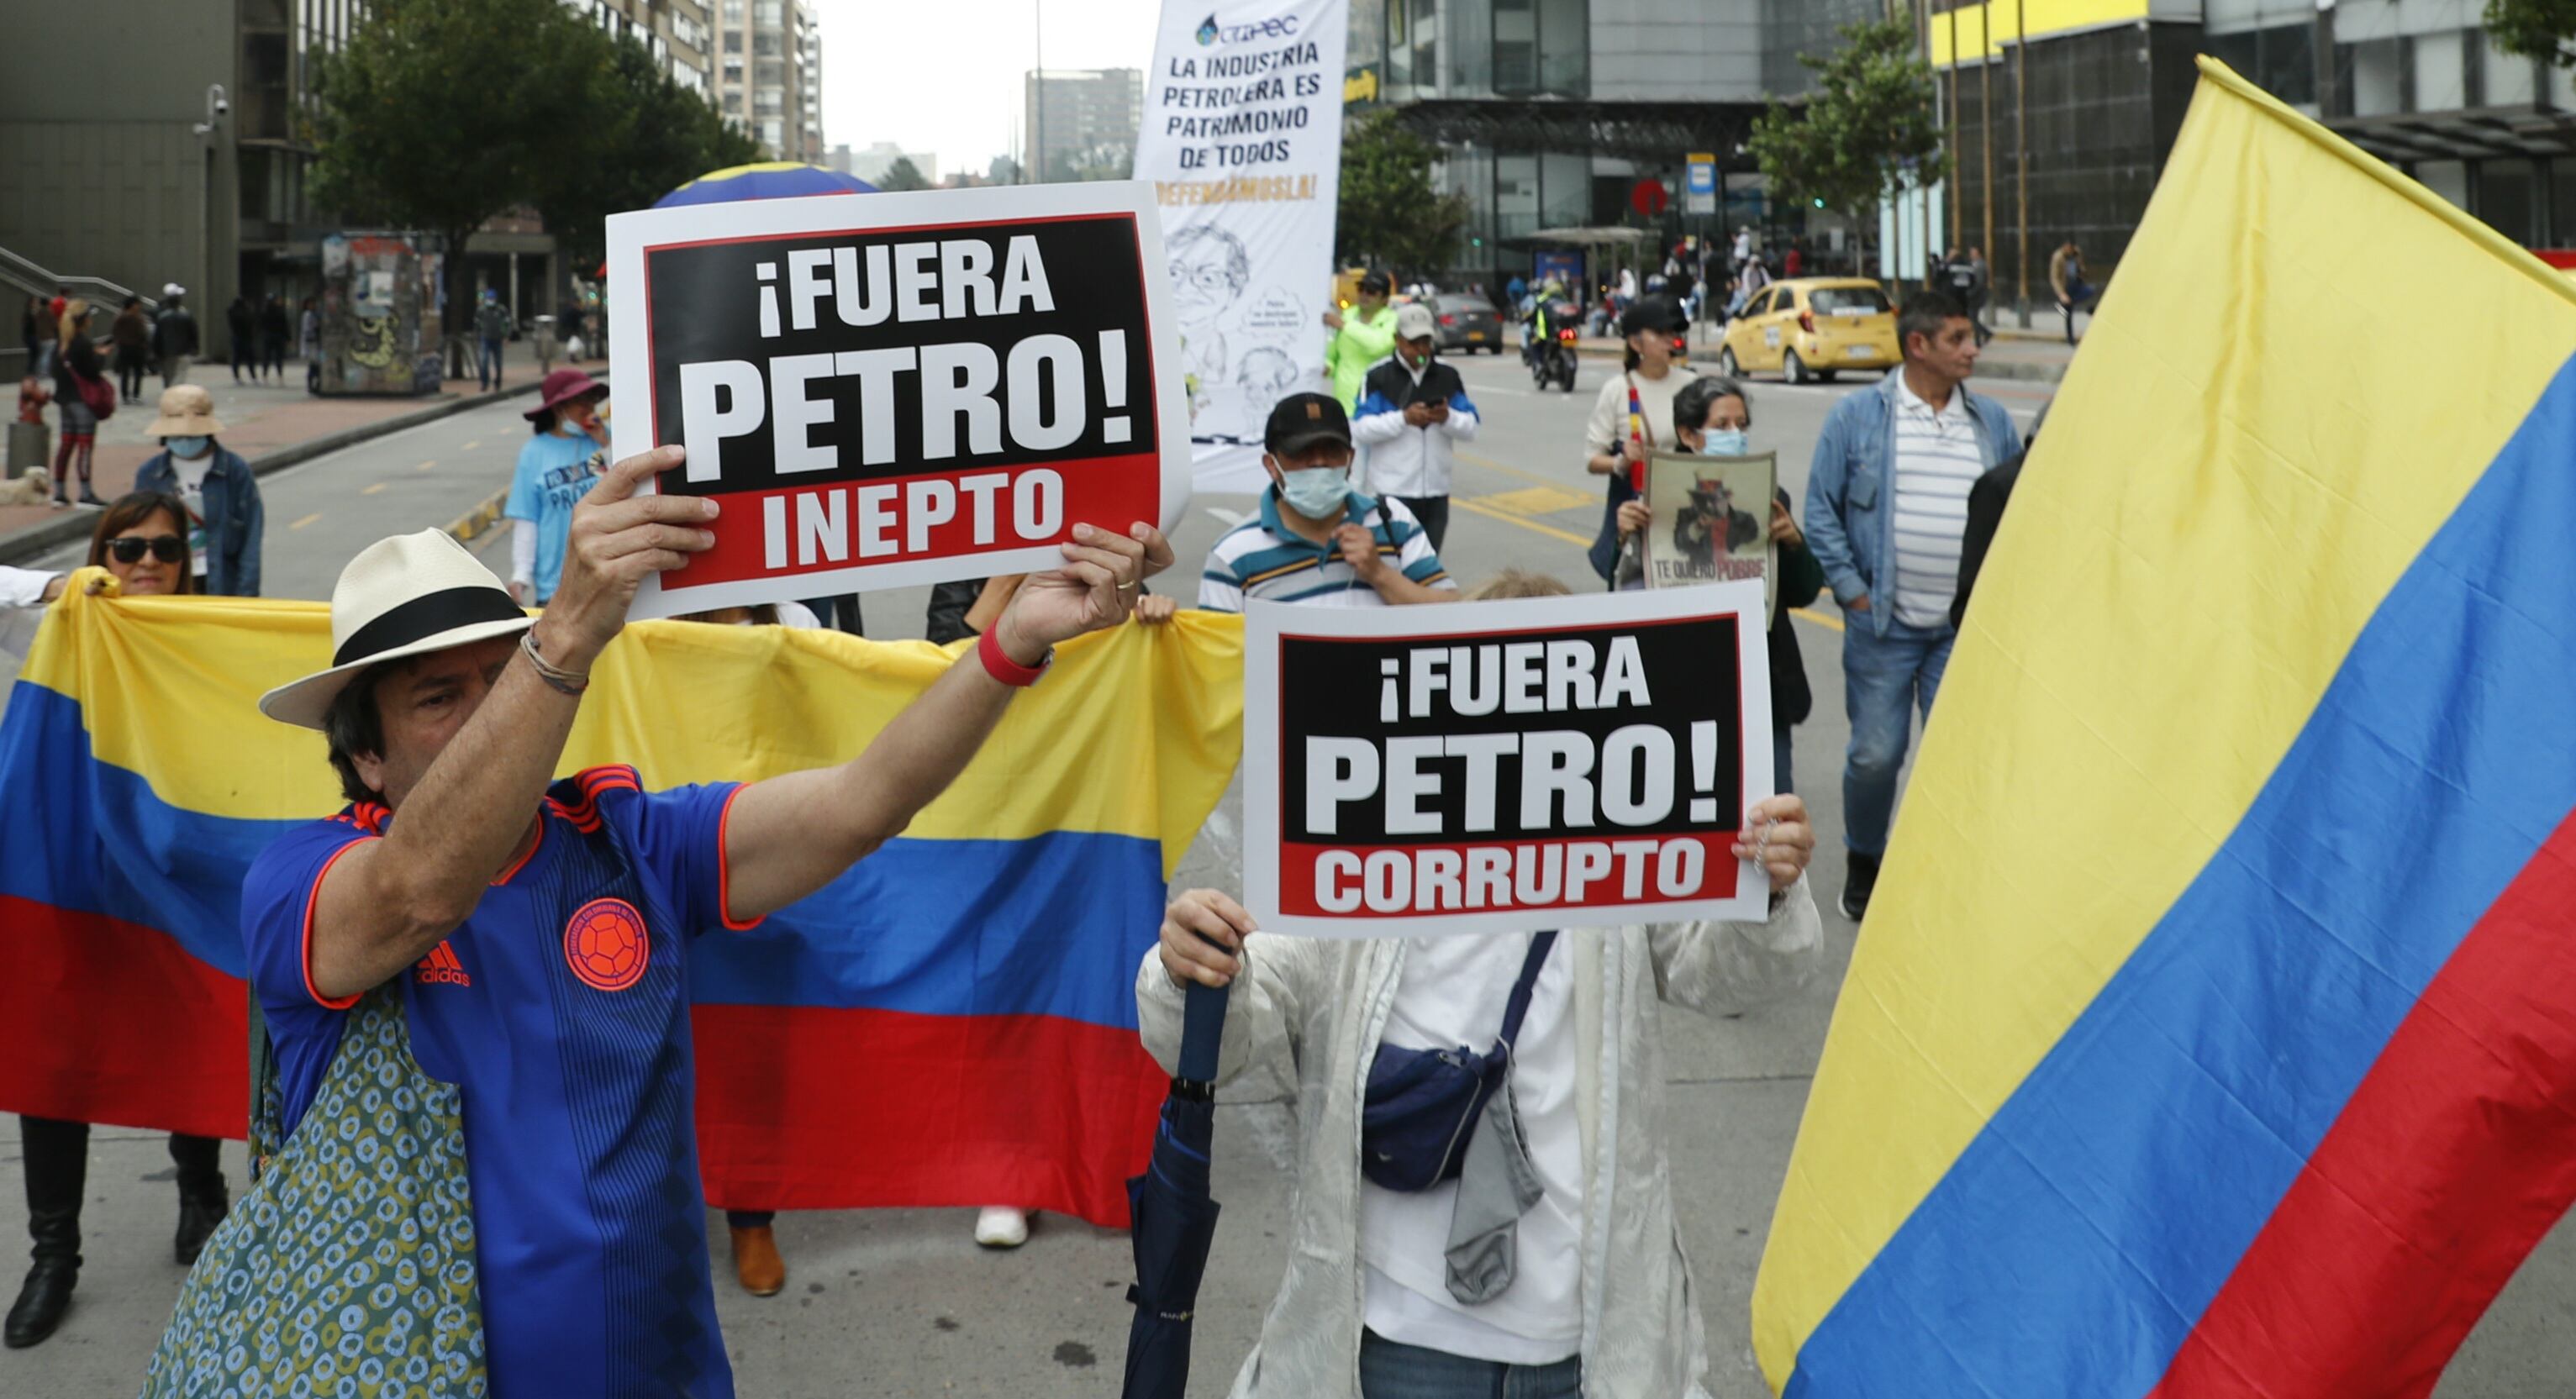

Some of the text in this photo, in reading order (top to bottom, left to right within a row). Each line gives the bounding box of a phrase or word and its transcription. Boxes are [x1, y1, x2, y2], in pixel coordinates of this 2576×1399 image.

[1163, 77, 1285, 108] PETROLERA
[1295, 74, 1320, 96] ES
[1170, 42, 1319, 78] LA INDUSTRIA
[1167, 106, 1308, 138] PATRIMONIO
[1179, 140, 1290, 169] DE TODOS
[756, 234, 1056, 338] ¡FUERA
[679, 329, 1131, 483] PETRO!
[763, 468, 1063, 570] INEPTO
[1655, 560, 1672, 579] TE
[1380, 635, 1651, 723] ¡FUERA
[1305, 720, 1717, 834] PETRO!
[1314, 838, 1704, 913] CORRUPTO
